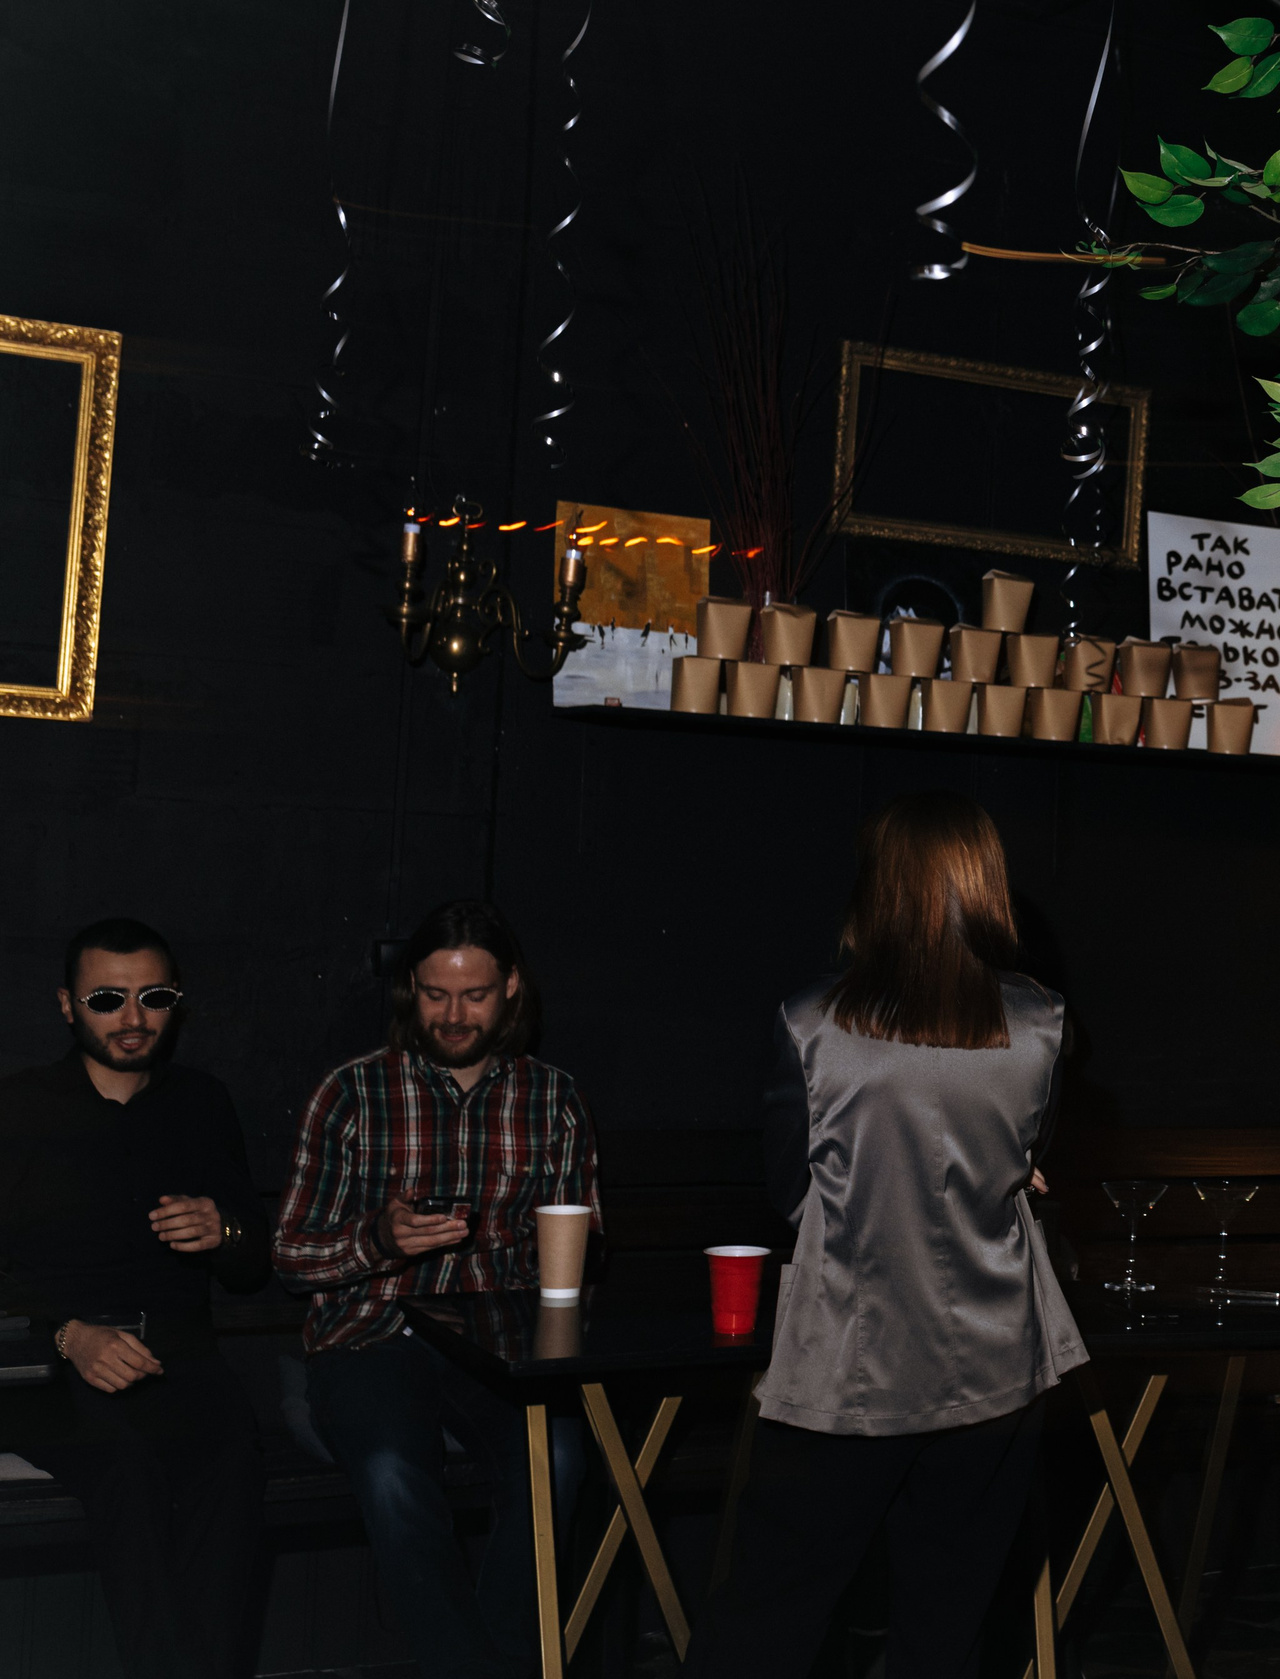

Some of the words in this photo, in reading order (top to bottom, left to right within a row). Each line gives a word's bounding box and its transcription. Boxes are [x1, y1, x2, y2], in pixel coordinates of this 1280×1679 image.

[1191, 533, 1250, 555] ТАК
[1166, 550, 1245, 580] РАНО
[1159, 636, 1280, 668] ТЬКО
[1218, 669, 1280, 694] З-ЗА
